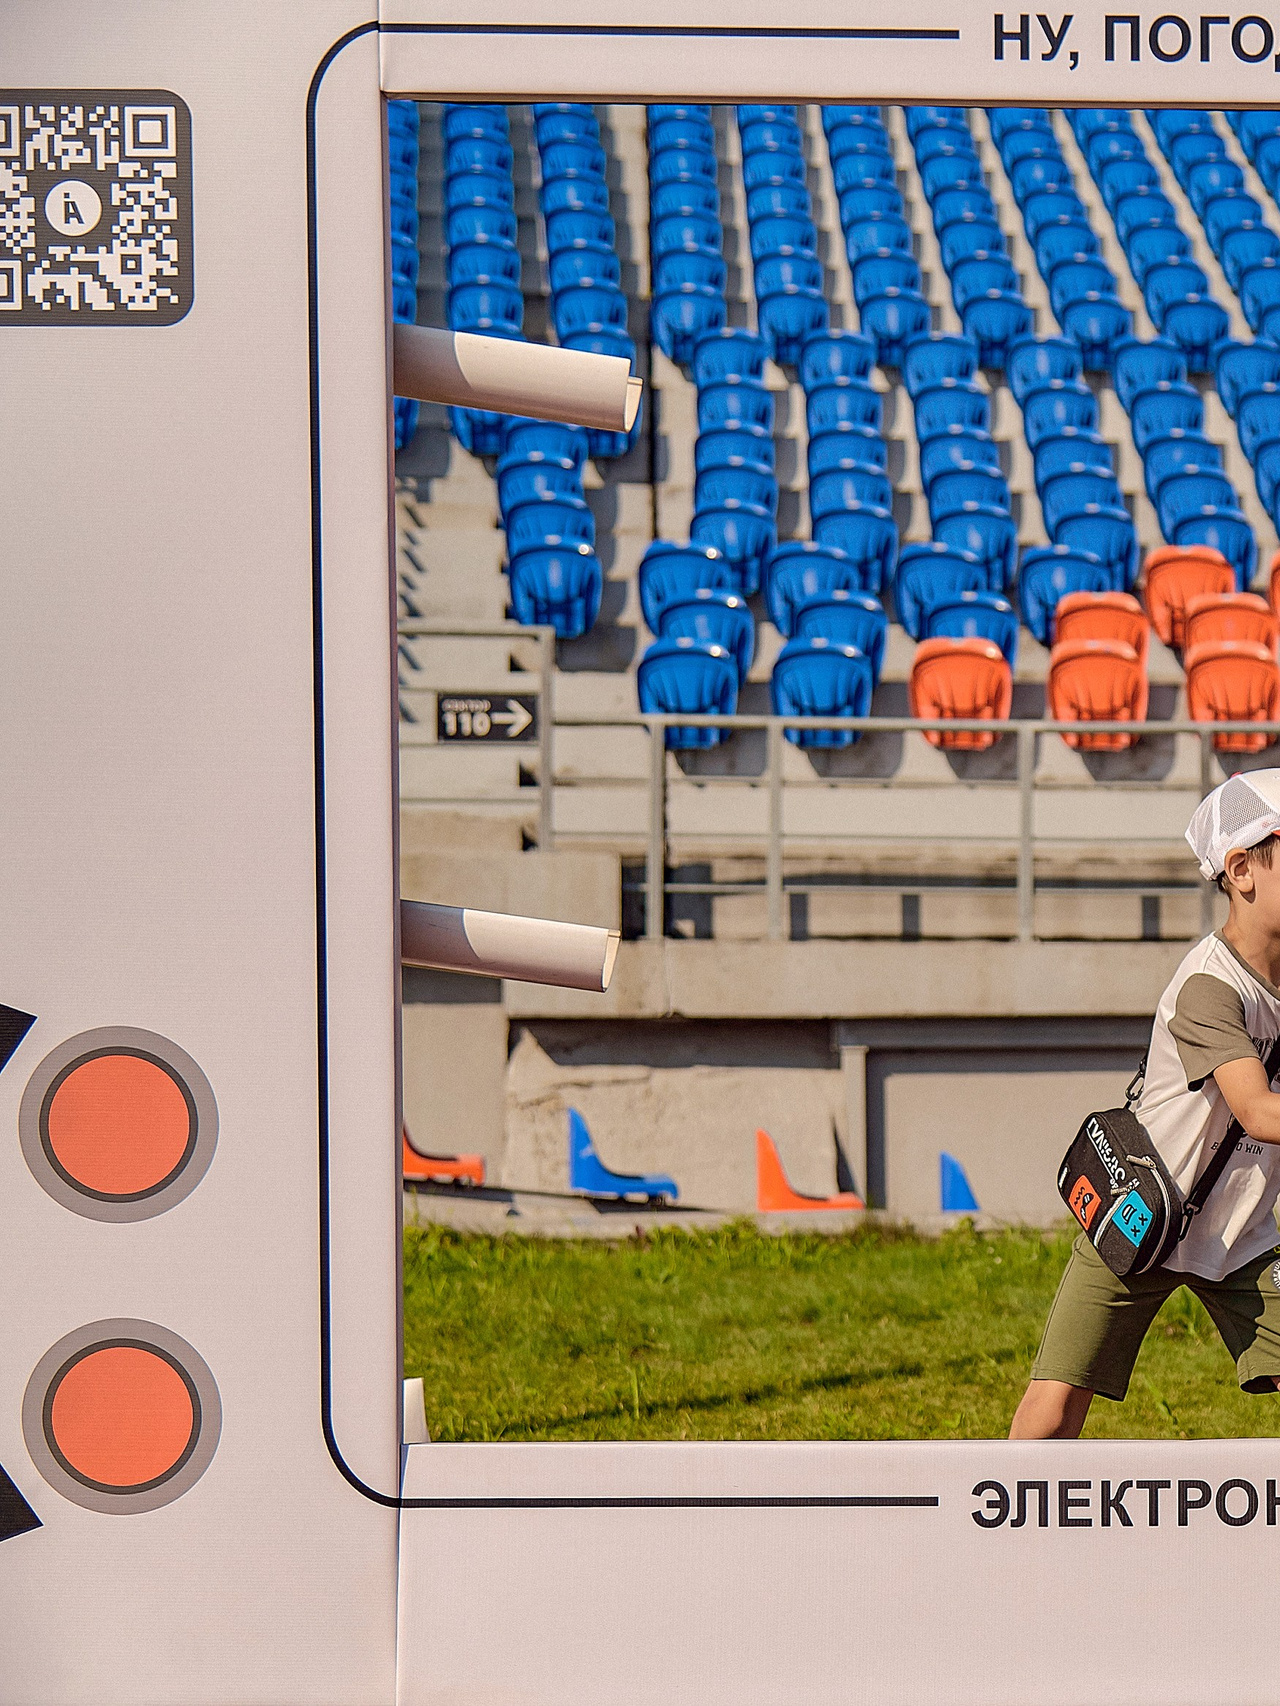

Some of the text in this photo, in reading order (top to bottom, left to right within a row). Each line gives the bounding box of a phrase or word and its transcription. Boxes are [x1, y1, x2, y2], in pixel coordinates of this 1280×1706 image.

[994, 13, 1079, 71] НУ,
[442, 711, 491, 737] 110
[1245, 1143, 1264, 1156] WIN
